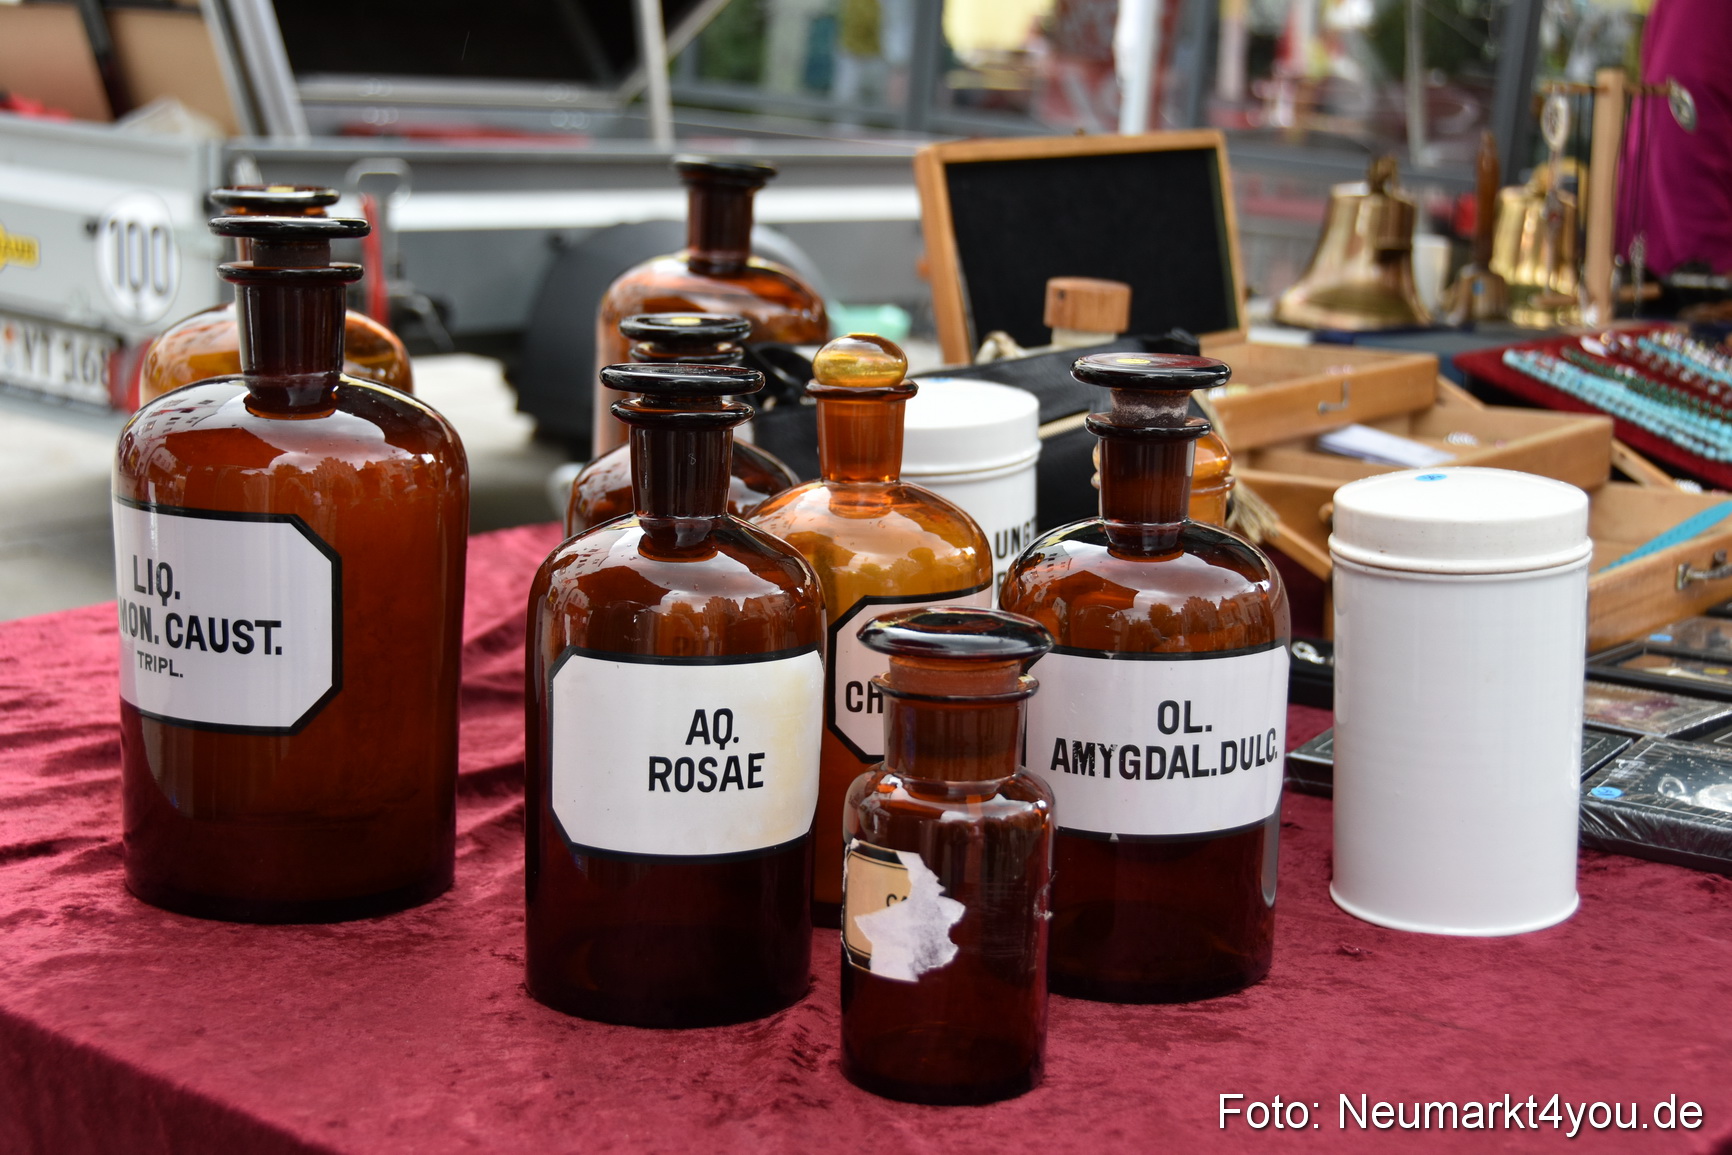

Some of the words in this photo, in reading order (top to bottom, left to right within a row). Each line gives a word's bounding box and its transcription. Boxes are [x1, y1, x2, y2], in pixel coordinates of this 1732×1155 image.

[109, 220, 169, 297] 100
[995, 519, 1036, 560] UNG
[133, 555, 181, 607] LIQ.
[119, 596, 160, 645] MON.
[165, 612, 283, 656] CAUST.
[137, 650, 184, 678] TRIPL.
[845, 680, 884, 714] CH
[1157, 700, 1213, 735] OL.
[685, 708, 739, 750] AQ.
[648, 752, 765, 792] ROSAE
